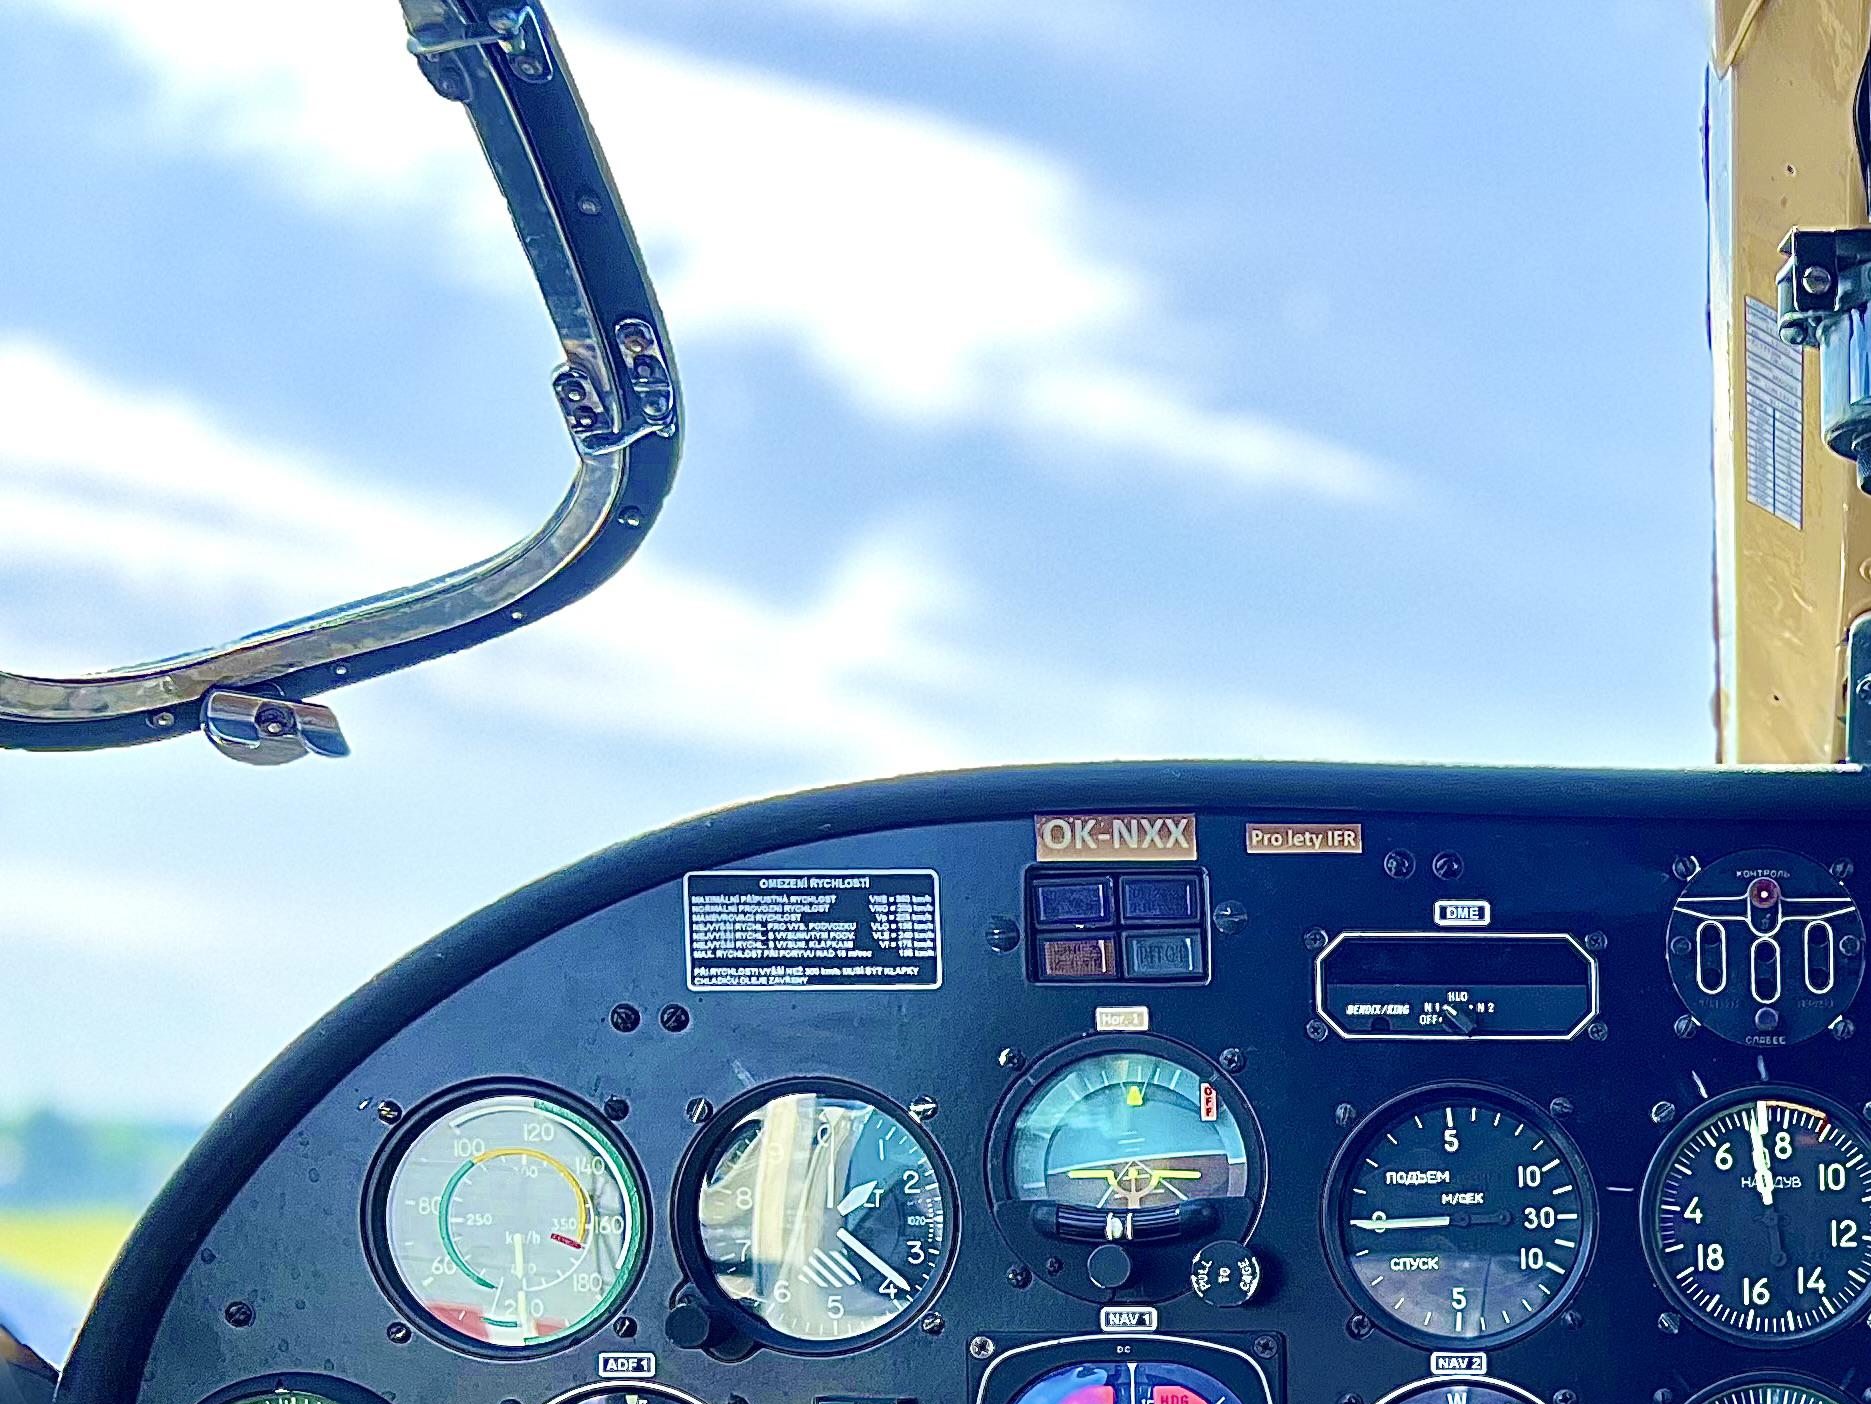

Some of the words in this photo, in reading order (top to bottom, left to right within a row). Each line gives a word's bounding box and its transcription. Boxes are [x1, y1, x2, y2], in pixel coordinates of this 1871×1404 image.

[1041, 817, 1191, 850] OK-NXX
[1251, 830, 1282, 848] Pro
[1287, 829, 1324, 850] lety
[1326, 830, 1357, 848] IFR
[1445, 907, 1480, 920] DME
[523, 1123, 555, 1141] 120
[1443, 1129, 1459, 1153] 5
[454, 1139, 485, 1158] 100
[1714, 1141, 1734, 1171] 6
[1385, 1170, 1451, 1186] ПОДЪЕМ
[1517, 1165, 1541, 1188] 10
[1818, 1163, 1846, 1192] 10
[1523, 1207, 1556, 1229] 30
[1831, 1219, 1858, 1248] 12
[1389, 1256, 1439, 1271] СПУСК
[1697, 1243, 1725, 1272] 18
[1743, 1277, 1771, 1306] 16
[1797, 1266, 1827, 1295] 14
[827, 1296, 845, 1319] 5
[1451, 1287, 1467, 1310] 5
[1108, 1313, 1140, 1327] NAV
[1142, 1312, 1152, 1327] 1
[605, 1358, 636, 1371] ADF
[1437, 1357, 1468, 1369] NAV
[1471, 1357, 1481, 1369] 2
